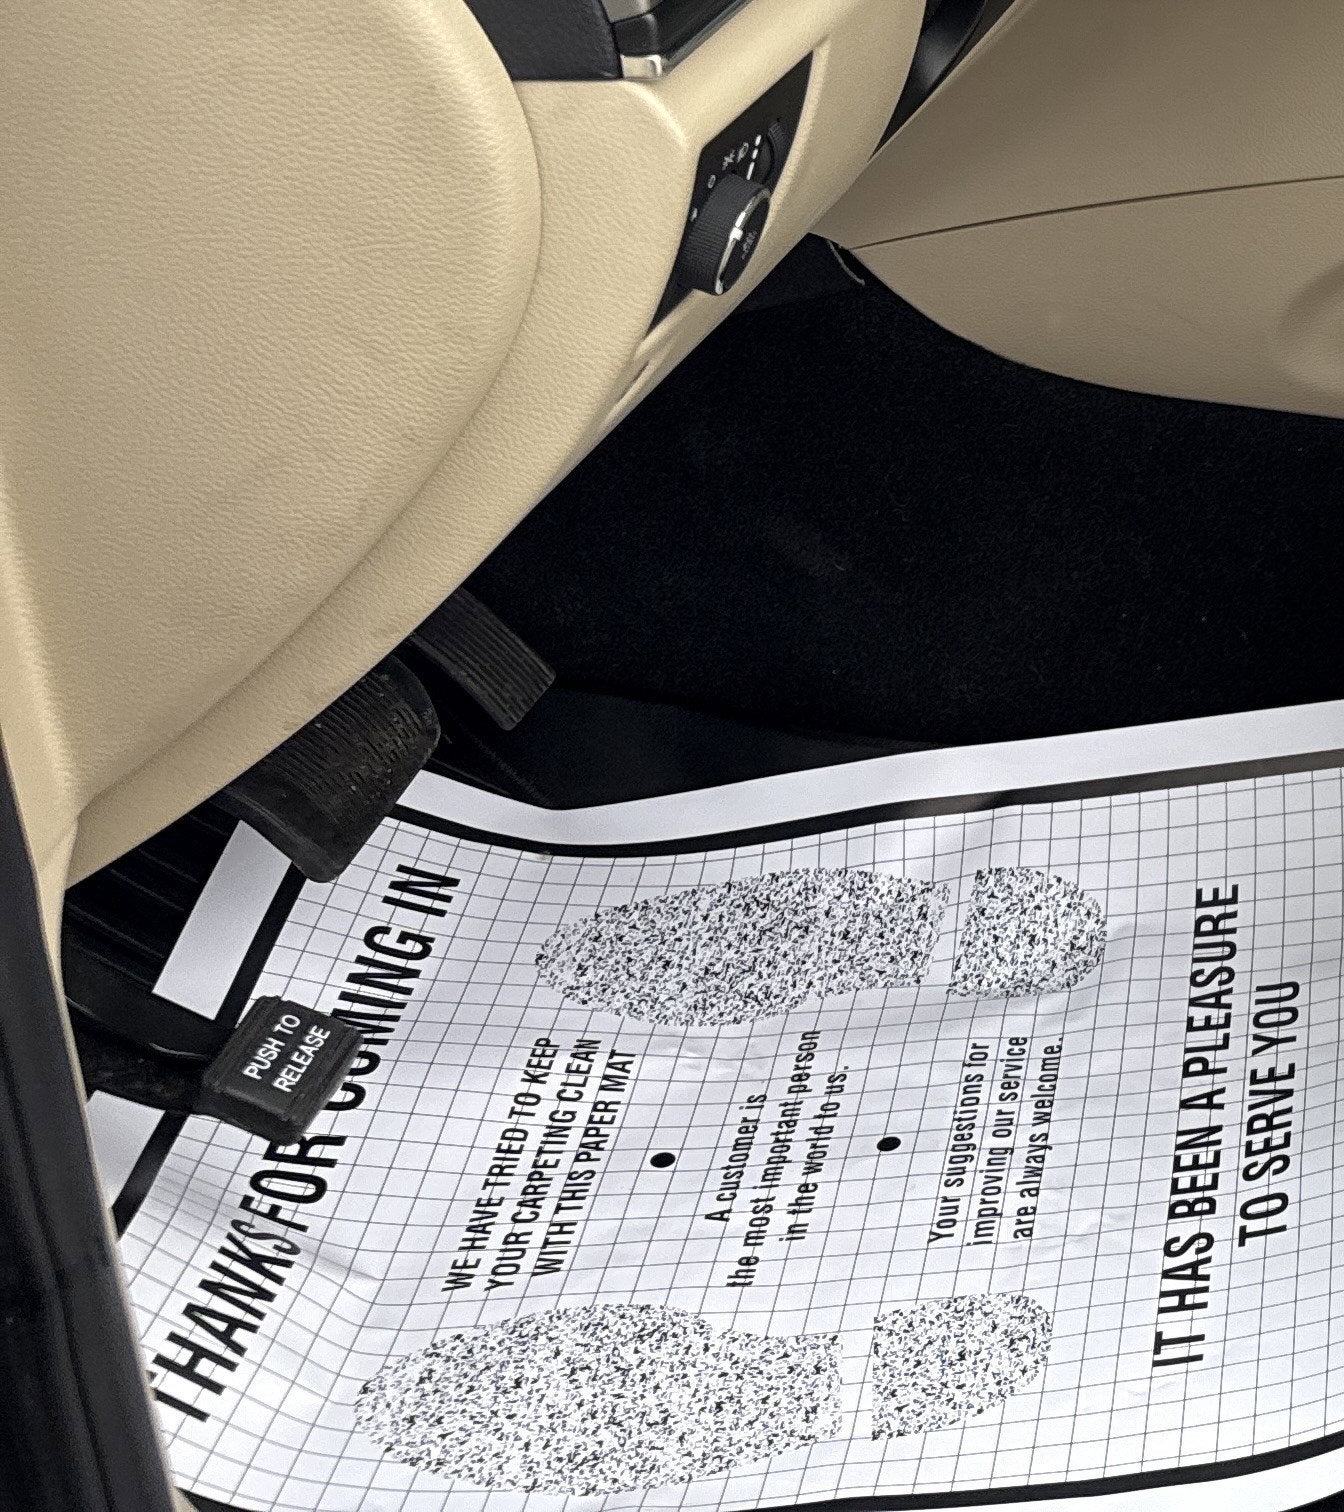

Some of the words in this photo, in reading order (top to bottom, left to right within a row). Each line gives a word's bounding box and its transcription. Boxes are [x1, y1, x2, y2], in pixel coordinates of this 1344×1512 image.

[1182, 884, 1239, 1078] PLEASURE
[1251, 981, 1300, 1056] YOU
[243, 1037, 286, 1080] PUSH
[274, 1014, 301, 1036] TO
[272, 1025, 331, 1093] RELEASE
[521, 1037, 561, 1085] KEEP
[599, 1049, 637, 1092] MAT
[787, 1030, 821, 1095] person
[962, 1042, 989, 1068] for
[999, 1036, 1028, 1102] service
[508, 1092, 541, 1119] TO
[739, 1093, 768, 1110] is
[825, 1065, 849, 1095] us.
[1030, 1037, 1063, 1127] welcome.
[1179, 1086, 1226, 1110] A
[574, 1100, 622, 1163] PAPER
[813, 1101, 841, 1119] to
[943, 1073, 984, 1188] suggestions
[992, 1109, 1015, 1138] our
[1242, 1063, 1295, 1182] SERVE
[147, 1218, 302, 1422] THANKS
[239, 1134, 348, 1232] FOR
[381, 864, 461, 917] IN
[481, 1128, 529, 1190] TRIED
[484, 1231, 533, 1292] YOUR
[511, 1109, 577, 1224] CARPETING
[557, 1039, 602, 1102] CLEAN
[716, 1117, 761, 1202] customer
[753, 1100, 803, 1190] important
[802, 1125, 835, 1176] world
[1015, 1132, 1053, 1198] always
[554, 1169, 597, 1214] THIS
[787, 1182, 818, 1216] the
[966, 1146, 1014, 1246] improving
[1168, 1124, 1224, 1220] BEEN
[459, 1196, 505, 1251] HAVE
[705, 1208, 732, 1223] A
[743, 1196, 776, 1247] most
[779, 1222, 810, 1242] in
[927, 1196, 961, 1244] Your
[1013, 1206, 1037, 1239] are
[1238, 1192, 1289, 1247] TO
[441, 1258, 482, 1292] WE
[531, 1221, 578, 1277] WITH
[726, 1256, 760, 1287] the
[1157, 1231, 1215, 1314] HAS
[1152, 1331, 1205, 1367] IT
